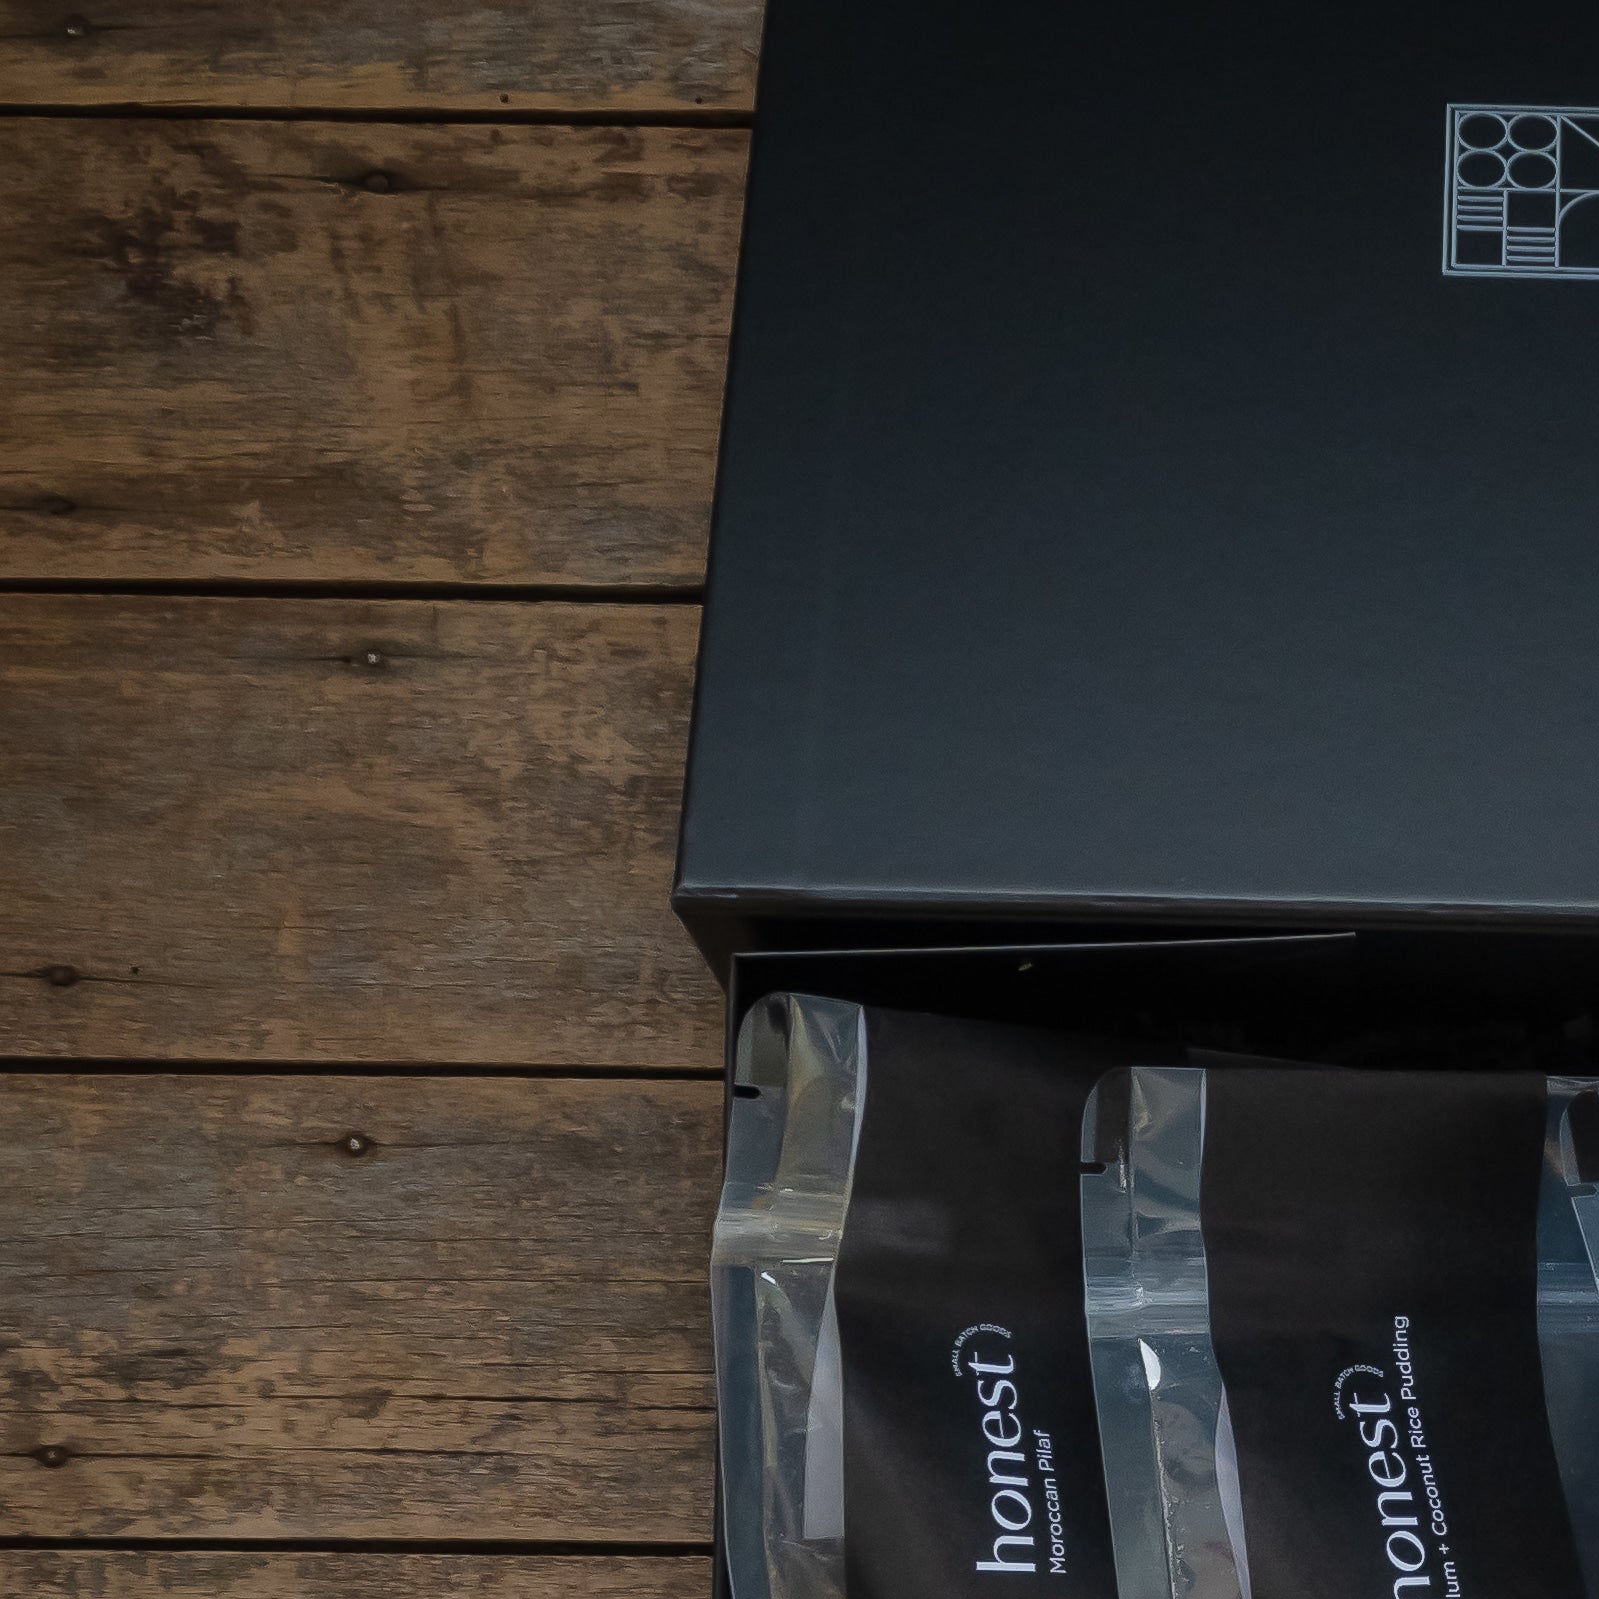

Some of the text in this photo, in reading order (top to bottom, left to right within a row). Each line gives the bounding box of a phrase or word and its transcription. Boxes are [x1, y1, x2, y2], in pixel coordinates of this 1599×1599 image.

[1334, 1367, 1355, 1389] BATCH
[1392, 1315, 1417, 1400] Pudding
[968, 1351, 1036, 1573] honest
[1407, 1406, 1427, 1448] Rice
[1032, 1429, 1067, 1574] Moroccan Pilaf
[1415, 1454, 1448, 1536] Coconut
[1438, 1543, 1450, 1555] +
